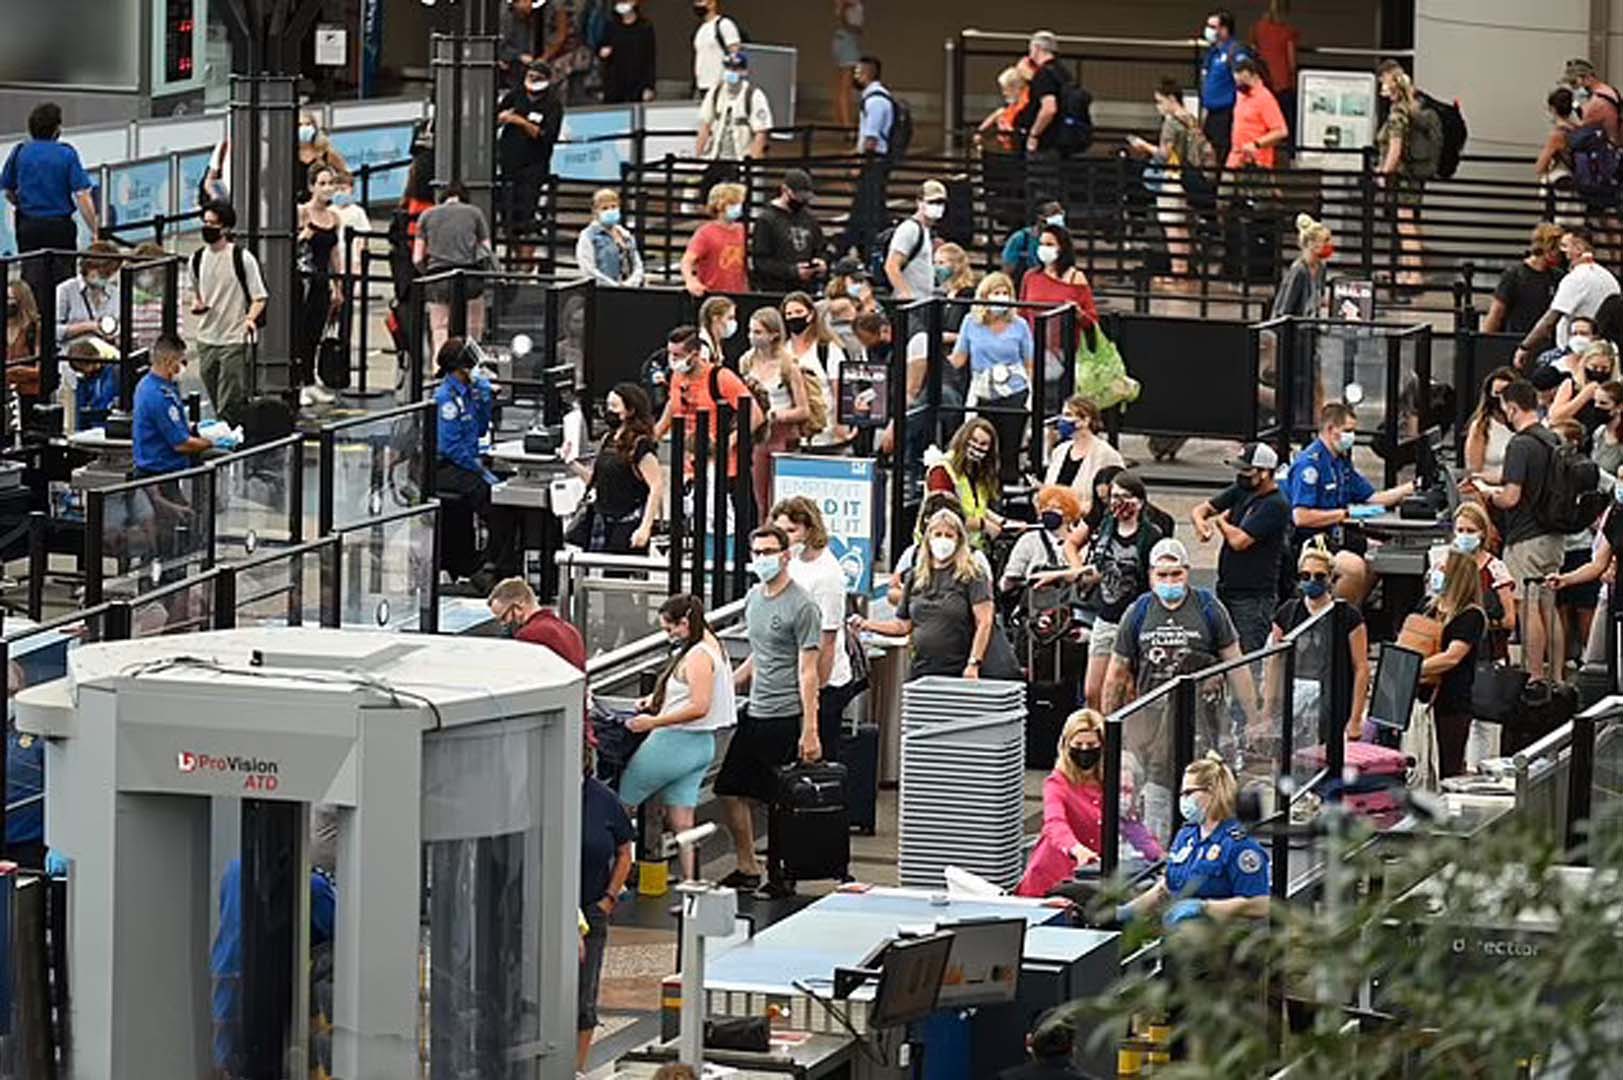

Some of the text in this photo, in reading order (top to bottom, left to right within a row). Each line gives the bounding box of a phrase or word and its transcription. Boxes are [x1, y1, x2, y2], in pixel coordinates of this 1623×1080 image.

[843, 501, 861, 515] IT
[845, 519, 860, 533] IT
[199, 754, 278, 774] ProVision
[244, 774, 278, 791] ATD
[687, 894, 695, 915] 7
